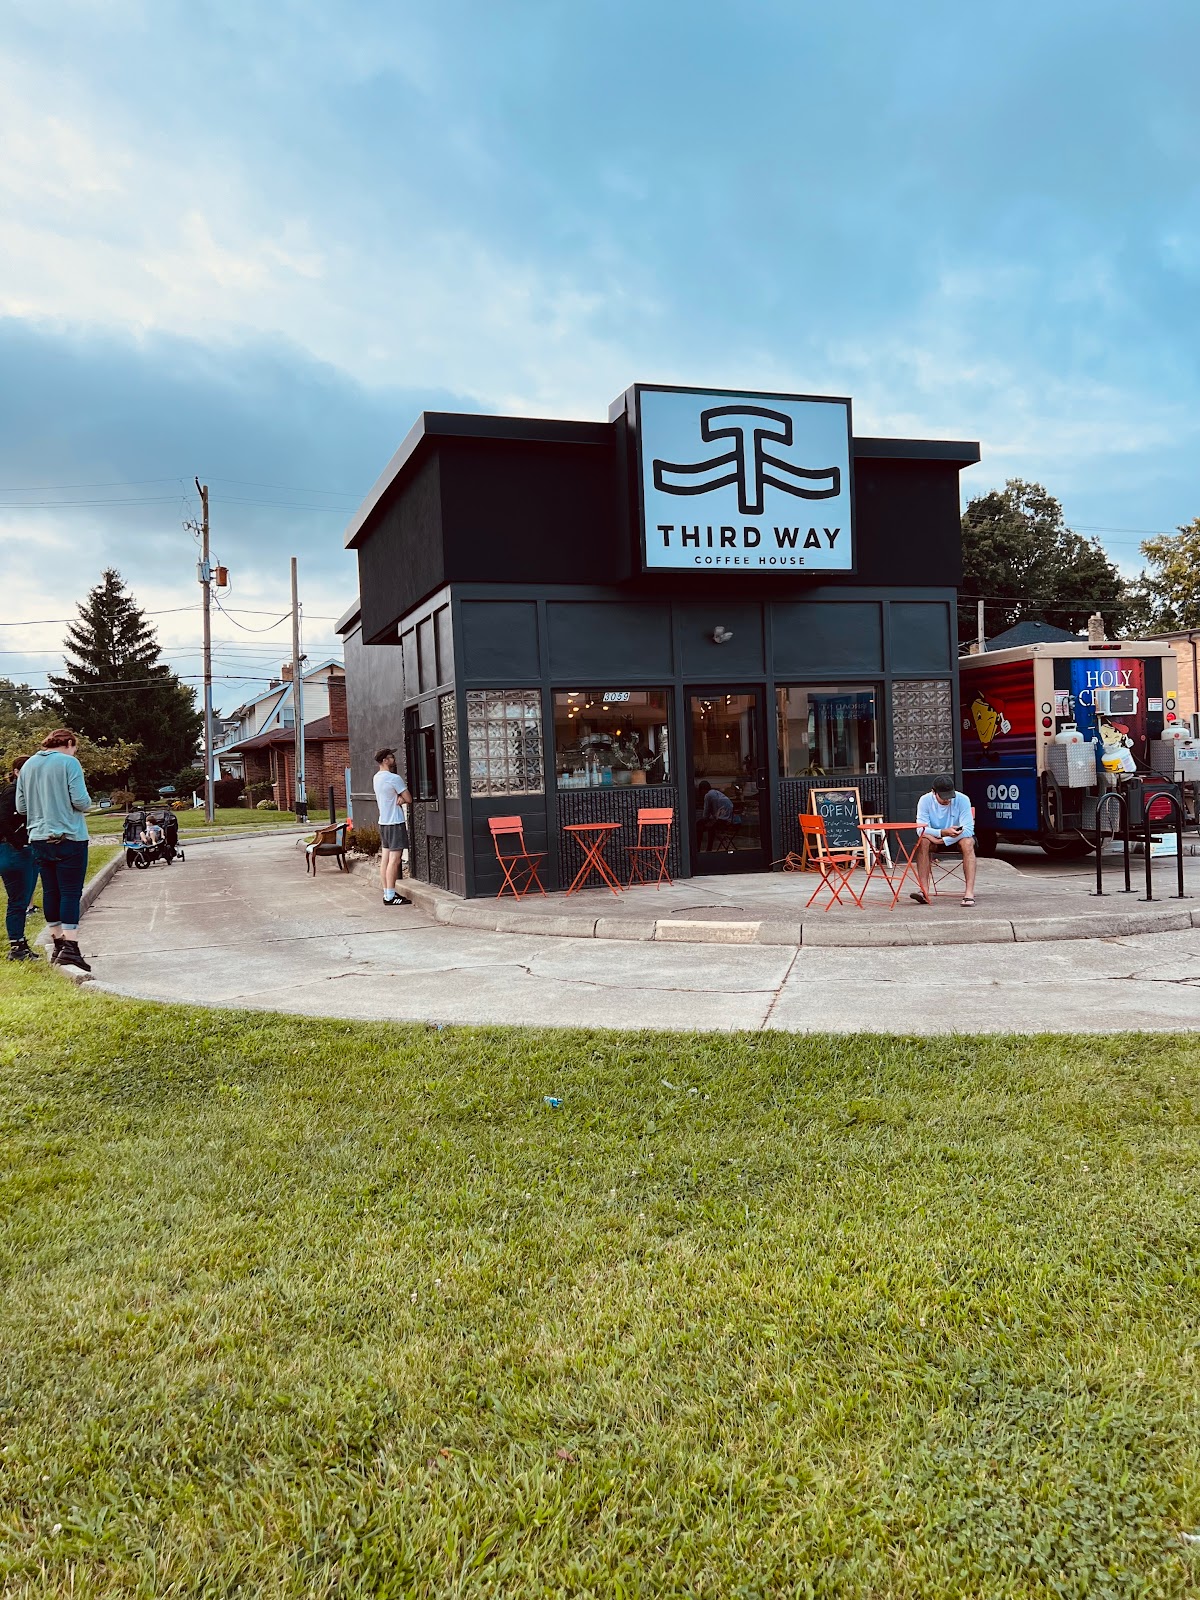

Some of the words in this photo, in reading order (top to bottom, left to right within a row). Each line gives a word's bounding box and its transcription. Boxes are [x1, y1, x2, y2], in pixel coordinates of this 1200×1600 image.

[657, 525, 762, 548] THIRD
[773, 527, 841, 549] WAY
[694, 556, 750, 565] COFFEE
[759, 556, 806, 566] HOUSE
[1086, 669, 1133, 688] HOLY
[604, 692, 629, 701] 3059
[820, 804, 859, 820] OPEN!
